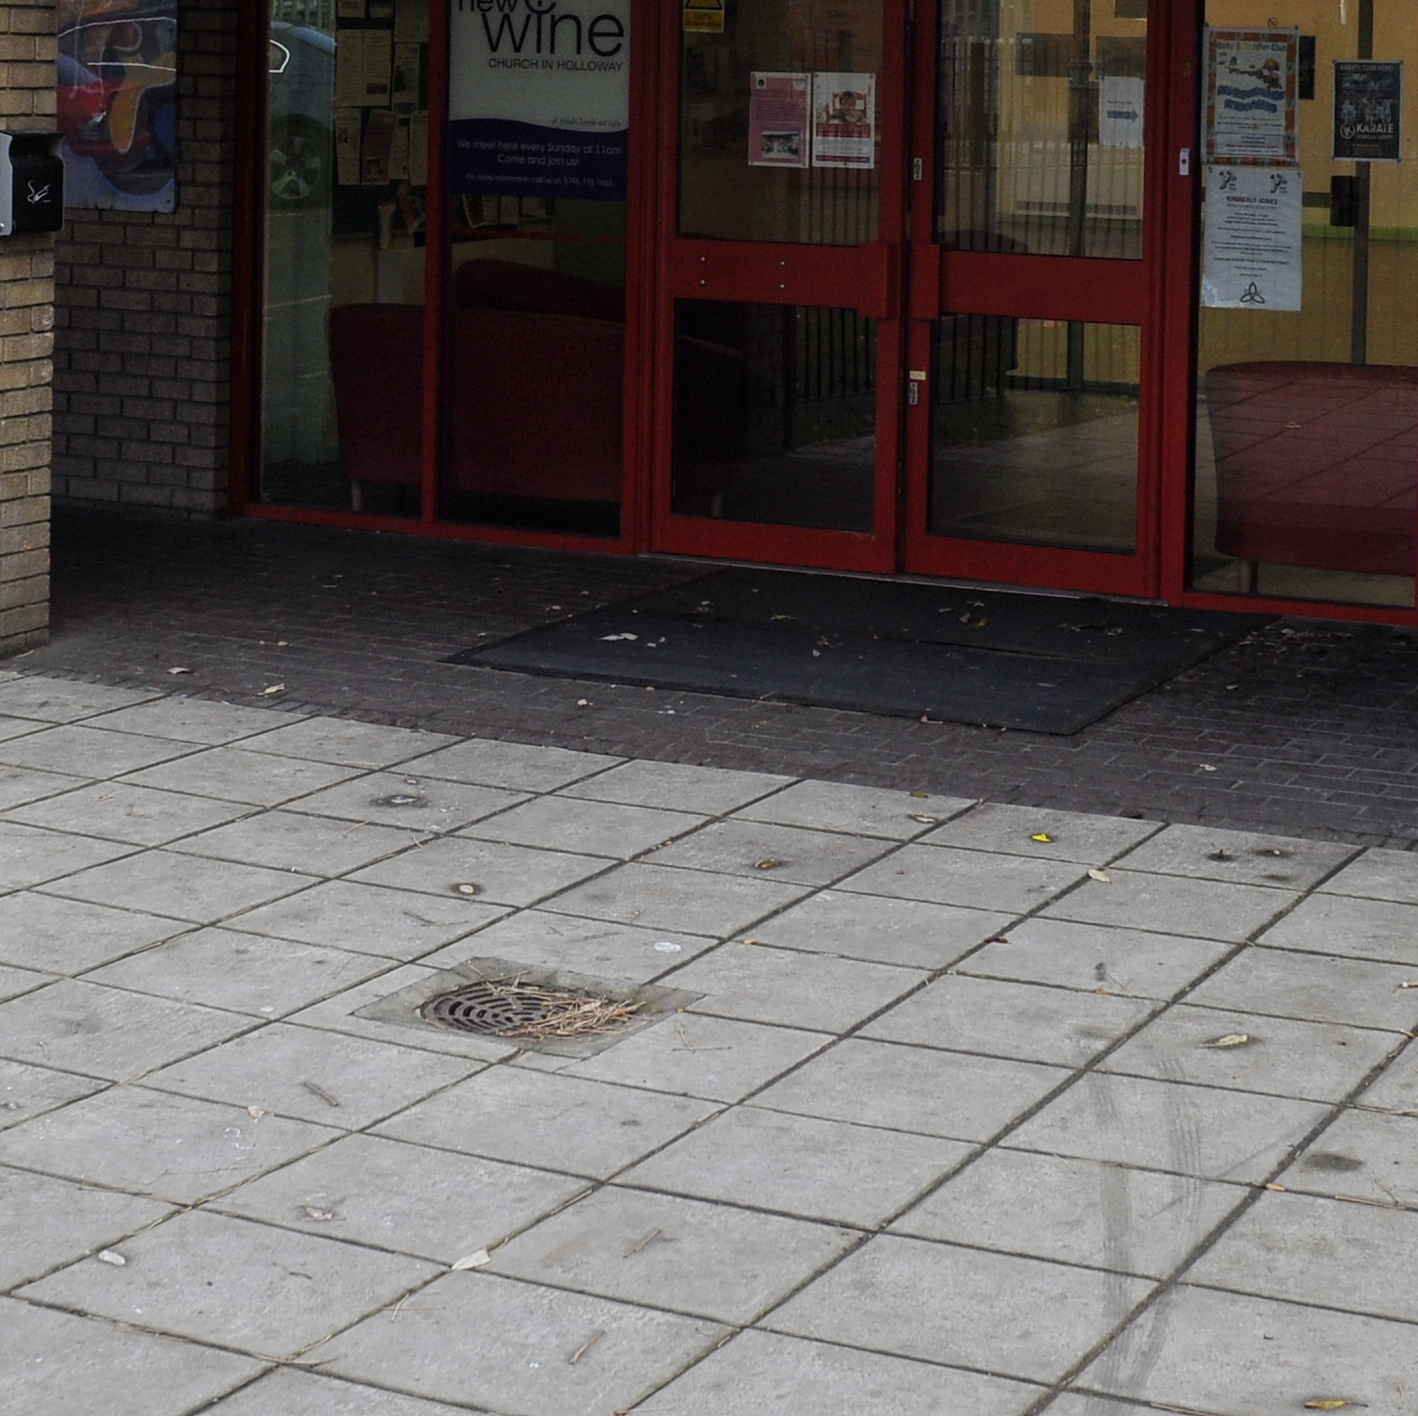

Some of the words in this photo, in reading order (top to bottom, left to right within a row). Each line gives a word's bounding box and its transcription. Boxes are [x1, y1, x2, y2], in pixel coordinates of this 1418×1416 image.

[488, 58, 538, 69] CHURCH
[542, 59, 554, 70] IN
[557, 60, 624, 72] HOLLOWAY
[1356, 122, 1394, 134] KARATE
[456, 139, 471, 149] We
[473, 140, 496, 150] meet
[497, 140, 518, 151] here
[520, 142, 545, 153] every
[547, 142, 581, 155] Sunday
[583, 144, 593, 154] at
[596, 145, 622, 155] 11am
[497, 153, 526, 164] Come
[527, 155, 546, 165] and
[547, 156, 565, 167] join
